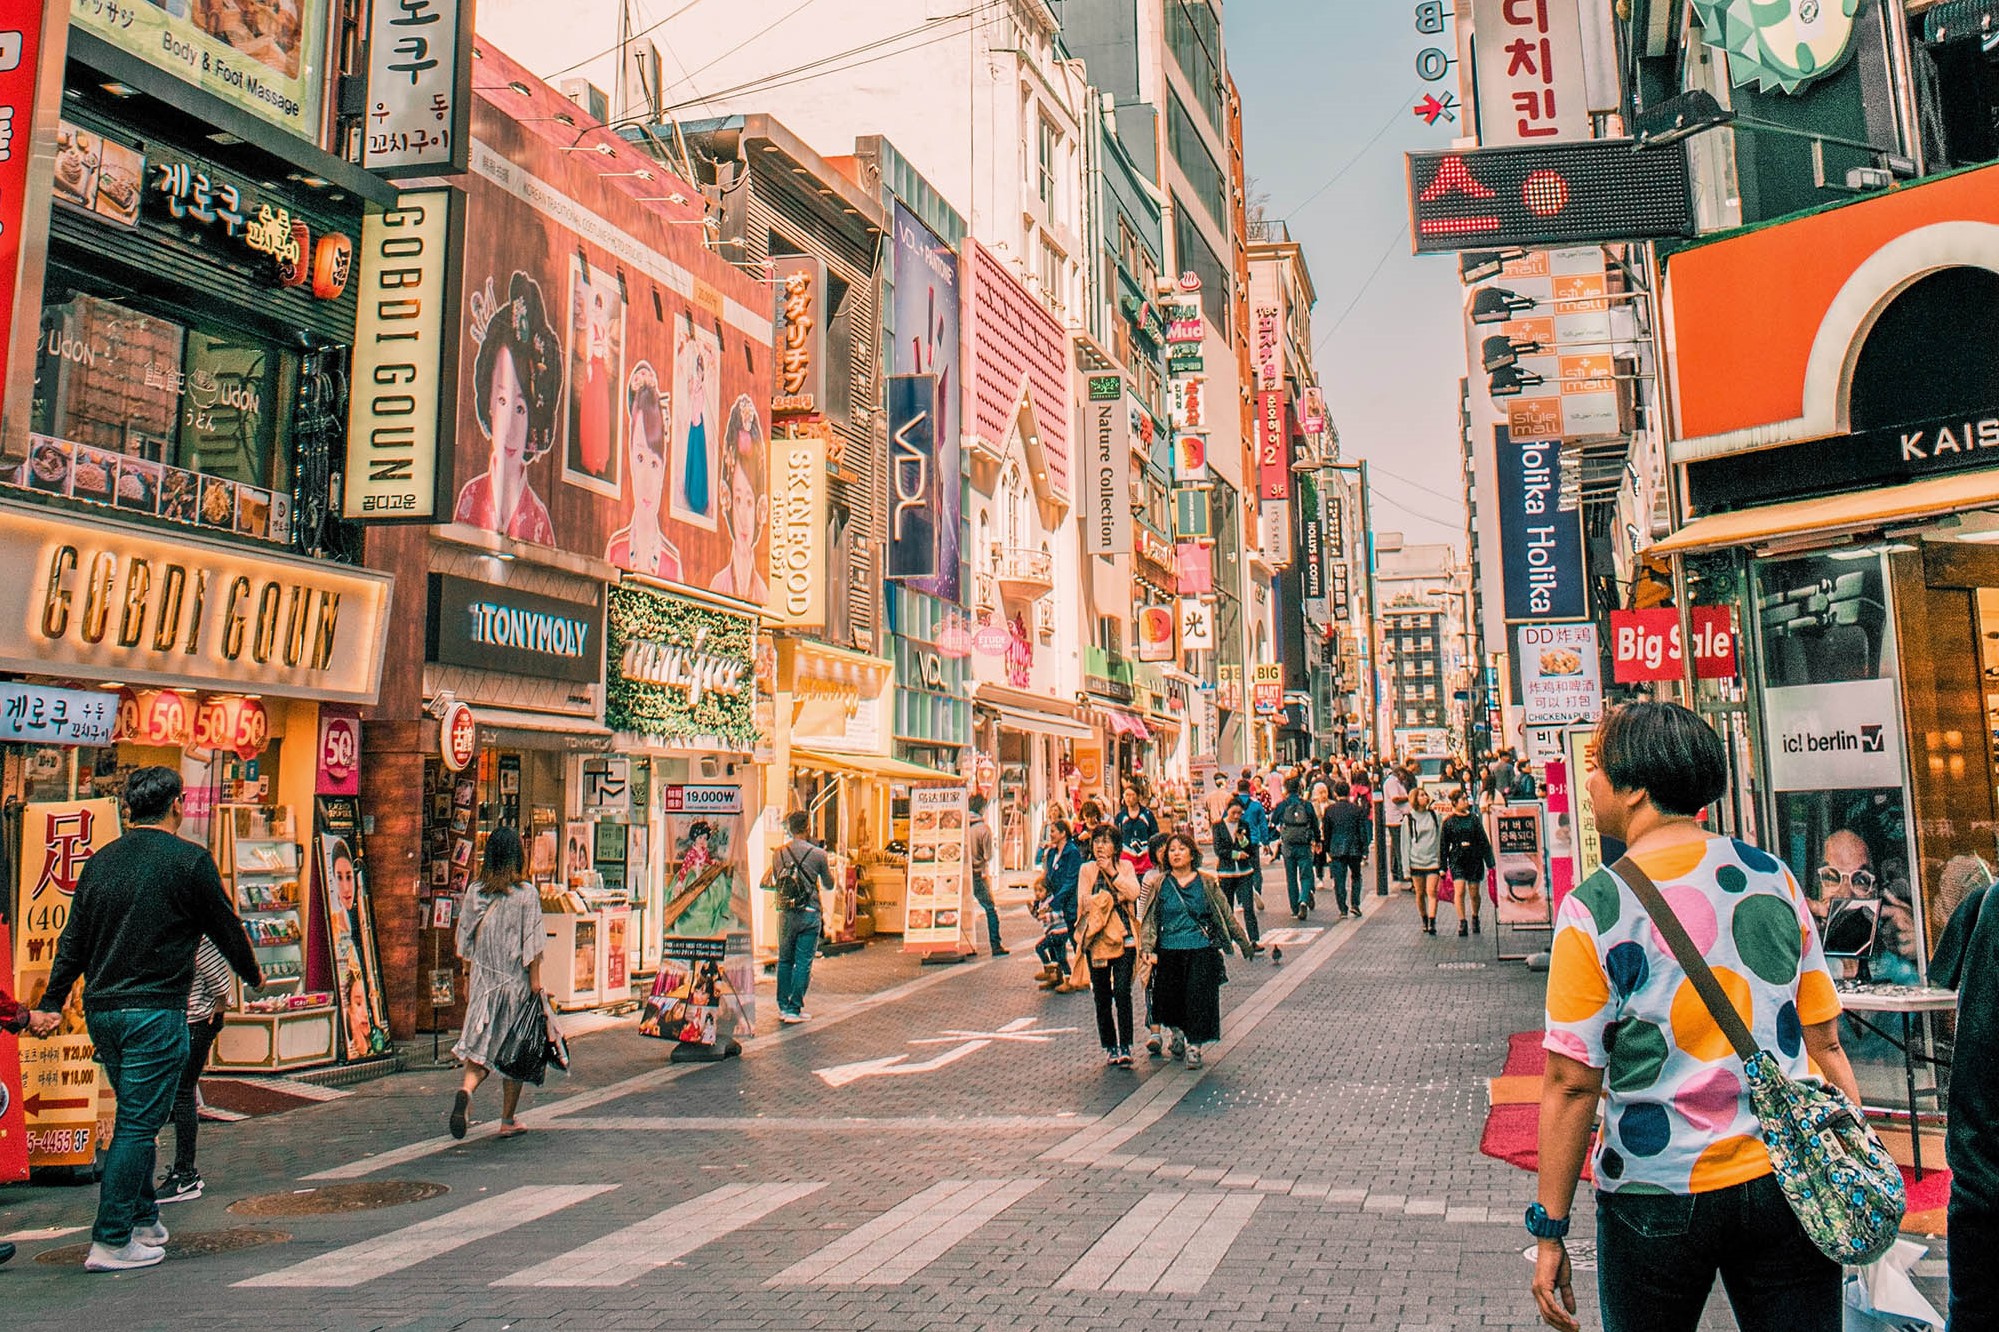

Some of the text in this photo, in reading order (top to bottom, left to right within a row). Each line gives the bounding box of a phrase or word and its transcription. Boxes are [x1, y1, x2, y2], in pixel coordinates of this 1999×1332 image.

[162, 31, 299, 116] Body & Foot Massage
[369, 129, 449, 154] 꼬치구이
[898, 220, 920, 255] VDL
[368, 205, 425, 482] GOBDI GOUN
[1166, 320, 1204, 339] Mud
[1514, 422, 1558, 435] mall
[1900, 418, 1999, 461] KAIS
[893, 410, 928, 542] VDL
[1264, 448, 1277, 465] 2
[1098, 405, 1115, 548] Nature Collection
[1271, 484, 1285, 495] 3F
[362, 494, 416, 511] 곱디고운
[787, 450, 812, 616] SKINFOOD
[1307, 521, 1320, 597] HOLLYS COFFEE
[1526, 525, 1558, 614] Holika
[41, 544, 341, 672] GOBDI GOUN
[1185, 611, 1207, 638] 光
[475, 602, 589, 657] TONYMOLY
[1526, 628, 1554, 645] DD
[1617, 621, 1731, 670] Big Sale
[918, 650, 948, 689] VDL
[1257, 667, 1279, 679] BIG
[1256, 685, 1280, 699] MART
[6, 694, 69, 735] 겐로쿠
[71, 722, 109, 742] 꼬치구이
[151, 702, 183, 741] 50
[197, 705, 226, 744] 50
[236, 708, 266, 747] 50
[326, 730, 352, 766] 50
[1783, 730, 1858, 753] ic! berlin
[32, 808, 95, 900] 足
[73, 1129, 90, 1152] 3F
